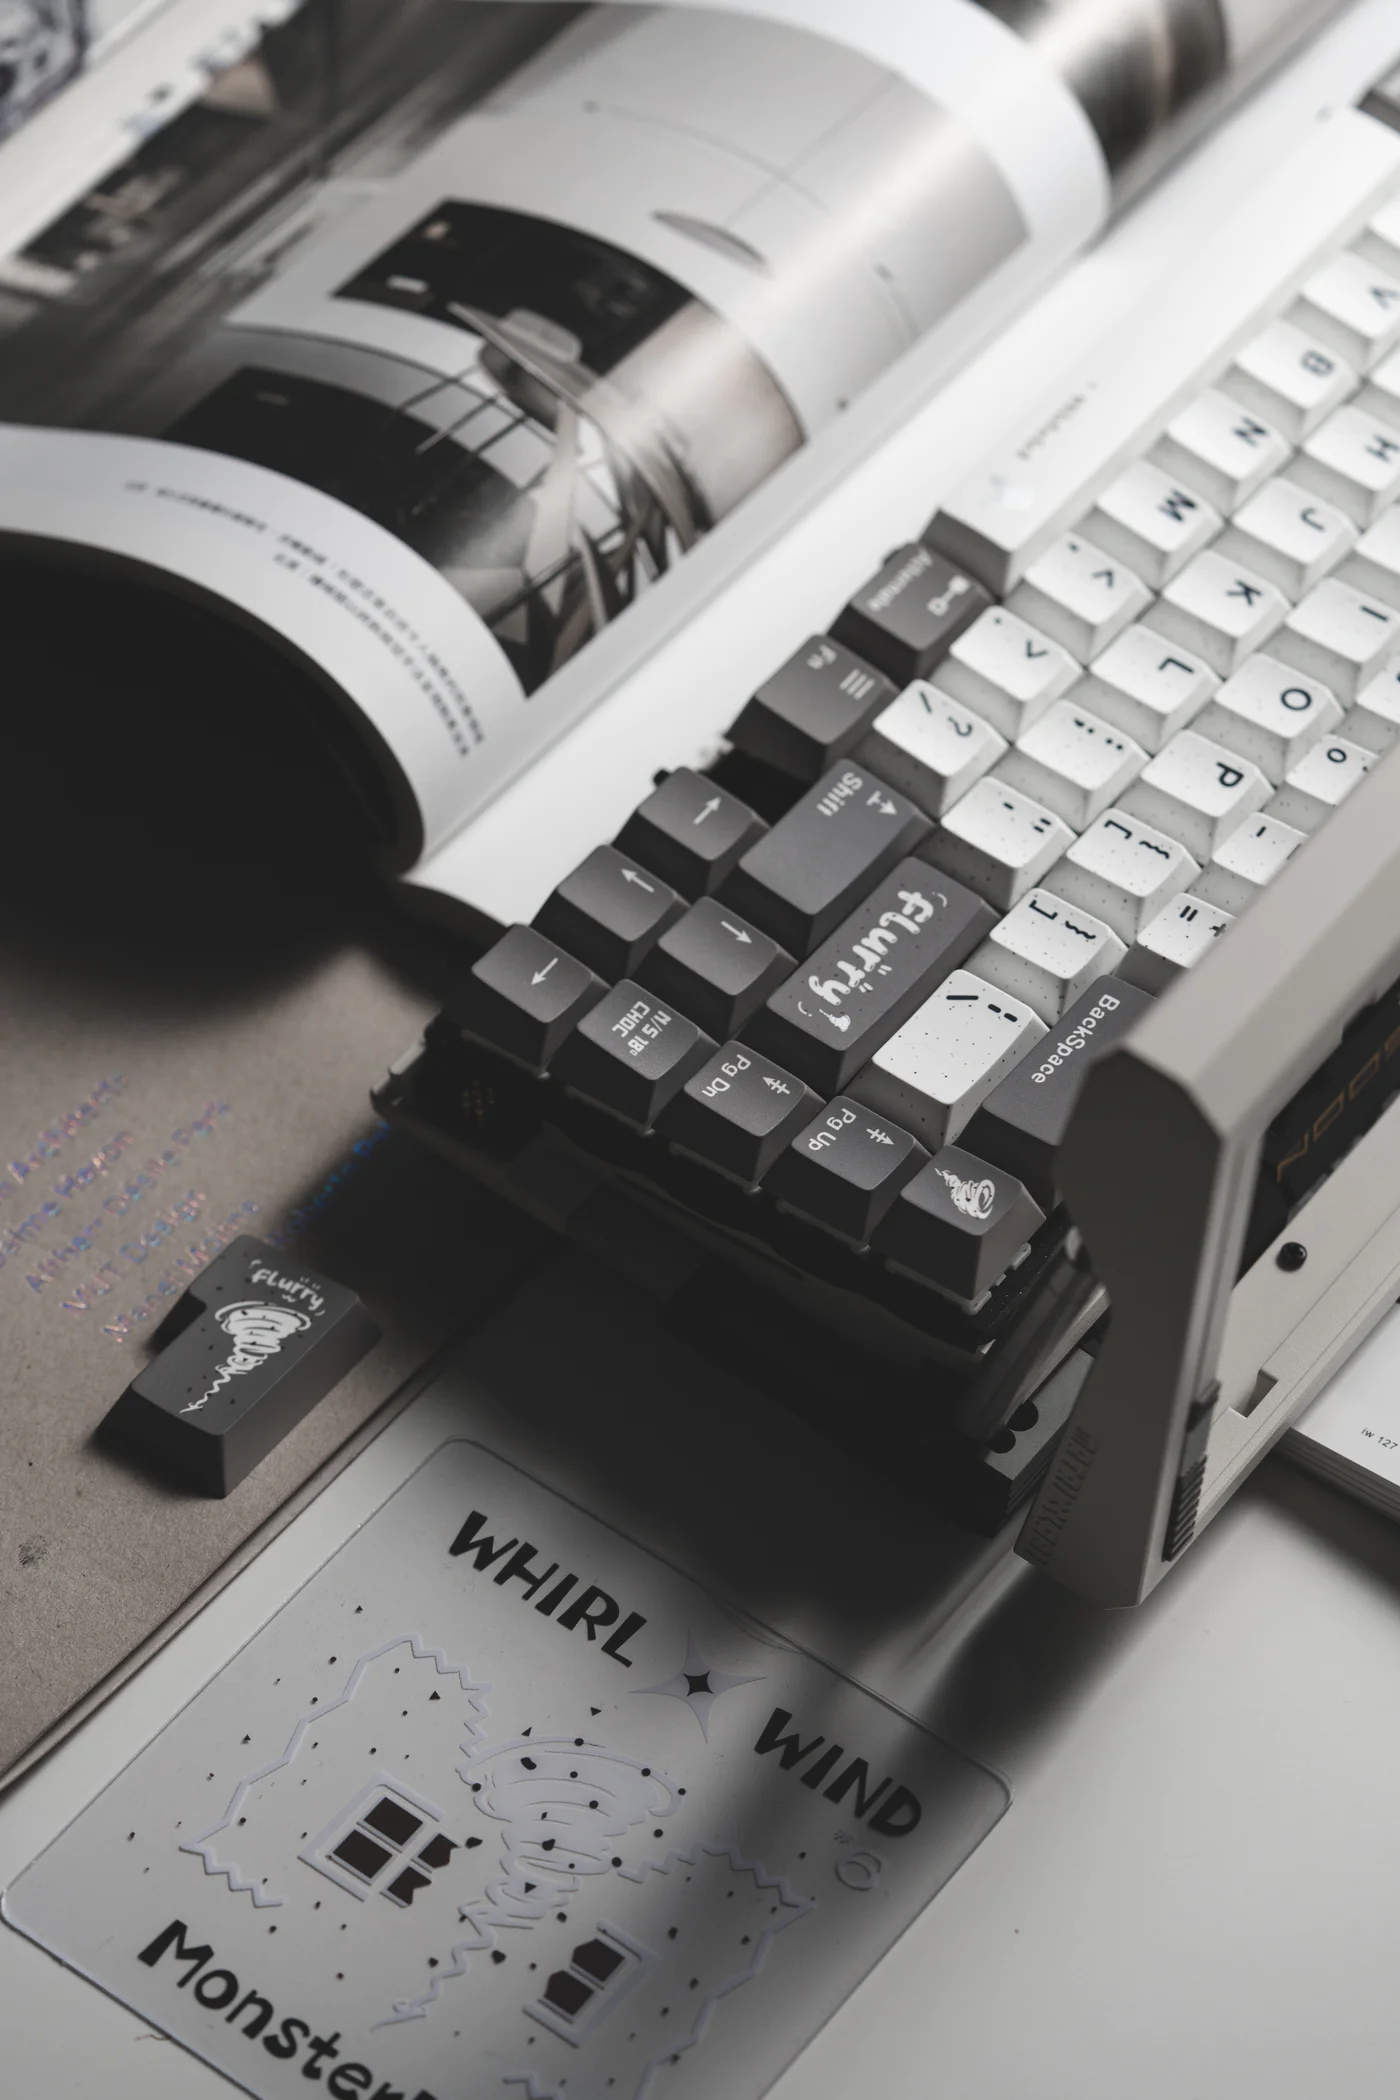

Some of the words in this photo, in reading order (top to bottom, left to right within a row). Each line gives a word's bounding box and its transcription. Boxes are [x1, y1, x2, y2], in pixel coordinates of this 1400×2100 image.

[1300, 350, 1334, 377] B
[1233, 416, 1268, 446] N
[1364, 434, 1400, 463] H
[1155, 488, 1198, 522] M
[1300, 507, 1325, 532] J
[1226, 578, 1263, 606] K
[1158, 656, 1195, 675] L
[1216, 762, 1244, 787] P
[816, 771, 864, 818] Shift
[611, 1000, 650, 1038] CHOC
[1031, 993, 1121, 1084] BackSpace
[721, 1053, 751, 1077] Pg
[701, 1077, 731, 1098] Dn
[826, 1108, 856, 1131] Pg
[808, 1131, 836, 1151] Up
[1378, 1436, 1398, 1449] 127
[448, 1510, 648, 1668] WHIRL
[753, 1707, 923, 1838] WIND
